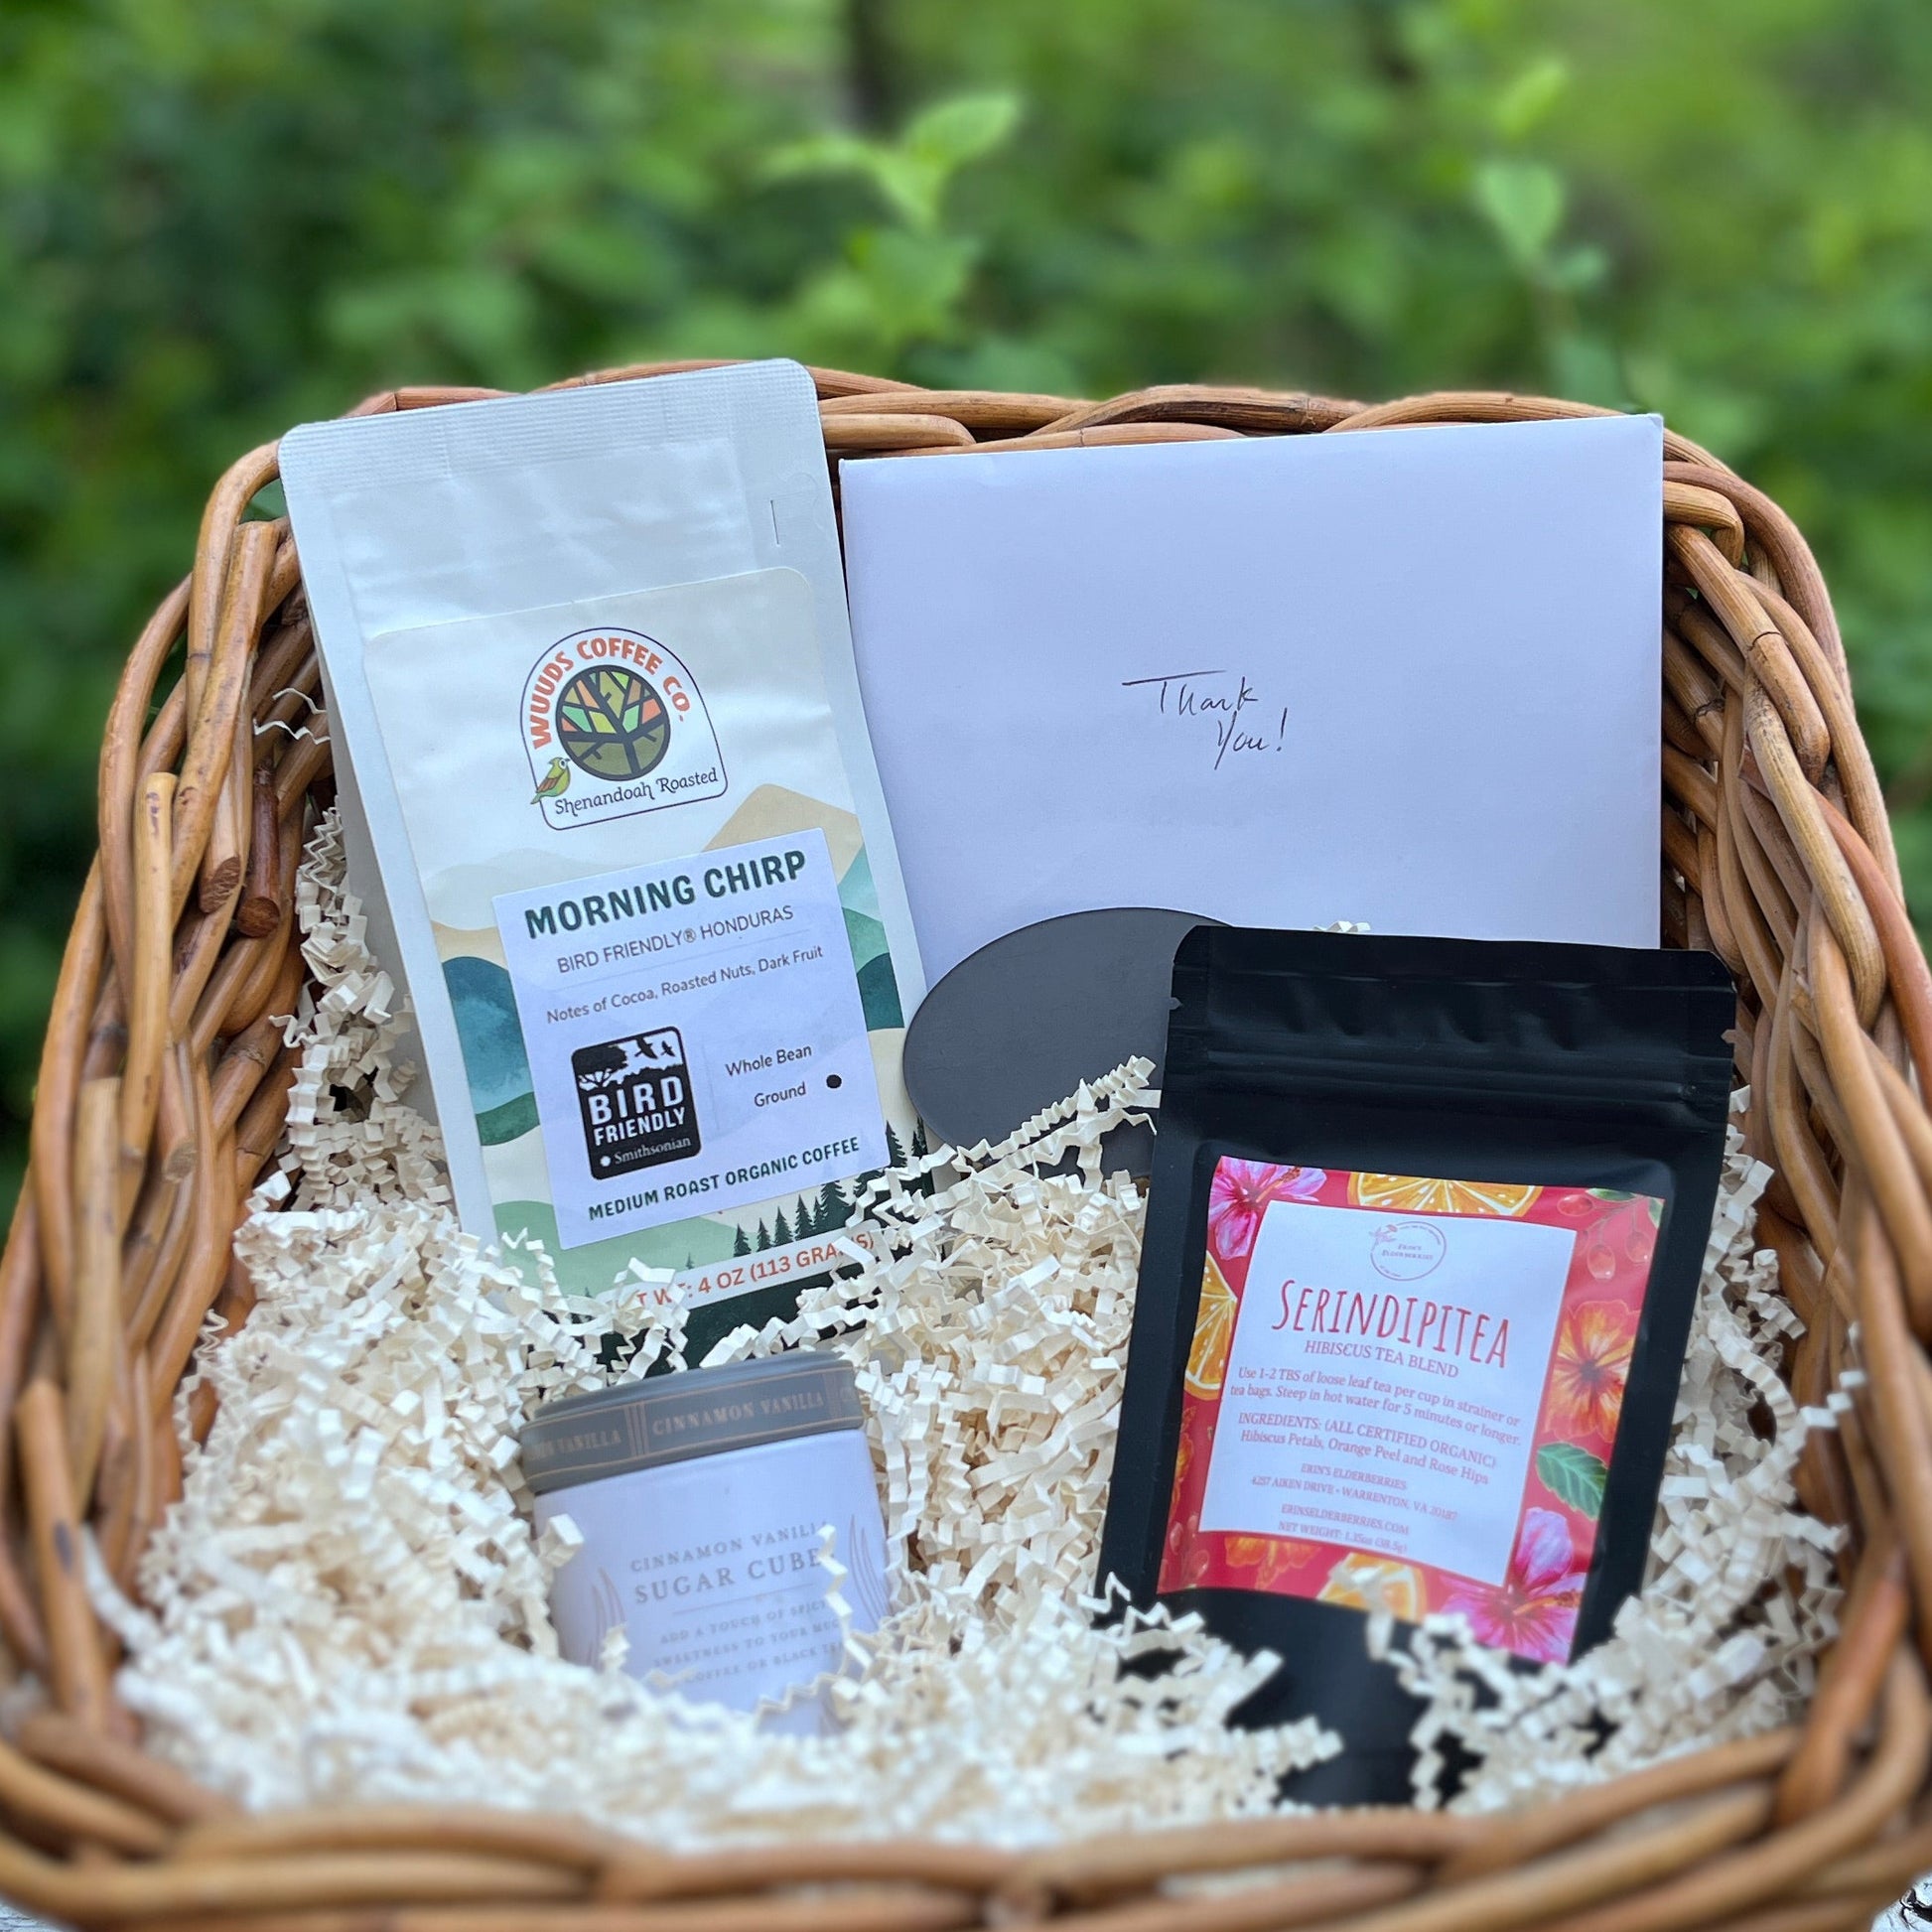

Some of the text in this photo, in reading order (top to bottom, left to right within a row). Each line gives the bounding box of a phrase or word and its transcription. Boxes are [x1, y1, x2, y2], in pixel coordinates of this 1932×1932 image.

[530, 637, 690, 750] WUUDS COFFEE CO.
[1122, 669, 1258, 716] Thank
[1214, 707, 1288, 770] You!
[555, 767, 718, 817] Shenandoah Roasted
[525, 851, 806, 939] MORNING CHIRP
[557, 950, 600, 974] BIRD
[700, 904, 793, 939] HONDURAS
[546, 944, 823, 1024] Notes of Cocoa, Roasted Nuts, Dark Fruit
[725, 1044, 812, 1077] Whole Bean
[588, 1075, 685, 1126] BIRD
[754, 1083, 806, 1108] Ground
[594, 1106, 687, 1147] FRIENDLY
[614, 1136, 691, 1166] Smithsonian
[589, 1136, 860, 1221] MEDIUM ROAST ORGANIC COFFEE
[698, 1276, 711, 1295] 4
[717, 1268, 745, 1289] OZ
[750, 1255, 791, 1282] (113
[796, 1233, 874, 1268] GRAS)
[1272, 1279, 1509, 1369] SERINDIPITEA
[1304, 1339, 1458, 1378] HIBISCUS TEA BLEND
[652, 1391, 825, 1436] CINNAMON VANILLA
[1231, 1385, 1245, 1396] tea
[1276, 1385, 1307, 1402] Steep
[1309, 1388, 1320, 1401] in
[1322, 1389, 1342, 1403] hot
[1346, 1394, 1380, 1409] water
[1382, 1398, 1401, 1413] for
[1403, 1403, 1412, 1415] 5
[1414, 1407, 1463, 1430] minutes
[1464, 1421, 1479, 1434] or
[1238, 1366, 1521, 1427] Use 1-2 TBS of loose leaf tea per cup in strainer or
[1238, 1412, 1496, 1468] INGREDIENTS: (ALL CERTIFIED ORGANIC)
[1241, 1430, 1286, 1445] Hibiscus
[1328, 1438, 1372, 1457] Orange
[1374, 1445, 1401, 1462] Peel
[1402, 1454, 1427, 1467] and
[1429, 1457, 1458, 1475] Rose
[1460, 1466, 1489, 1485] Hips
[629, 1538, 743, 1573] CINNAMON
[634, 1547, 835, 1604] SUGAR CUBE
